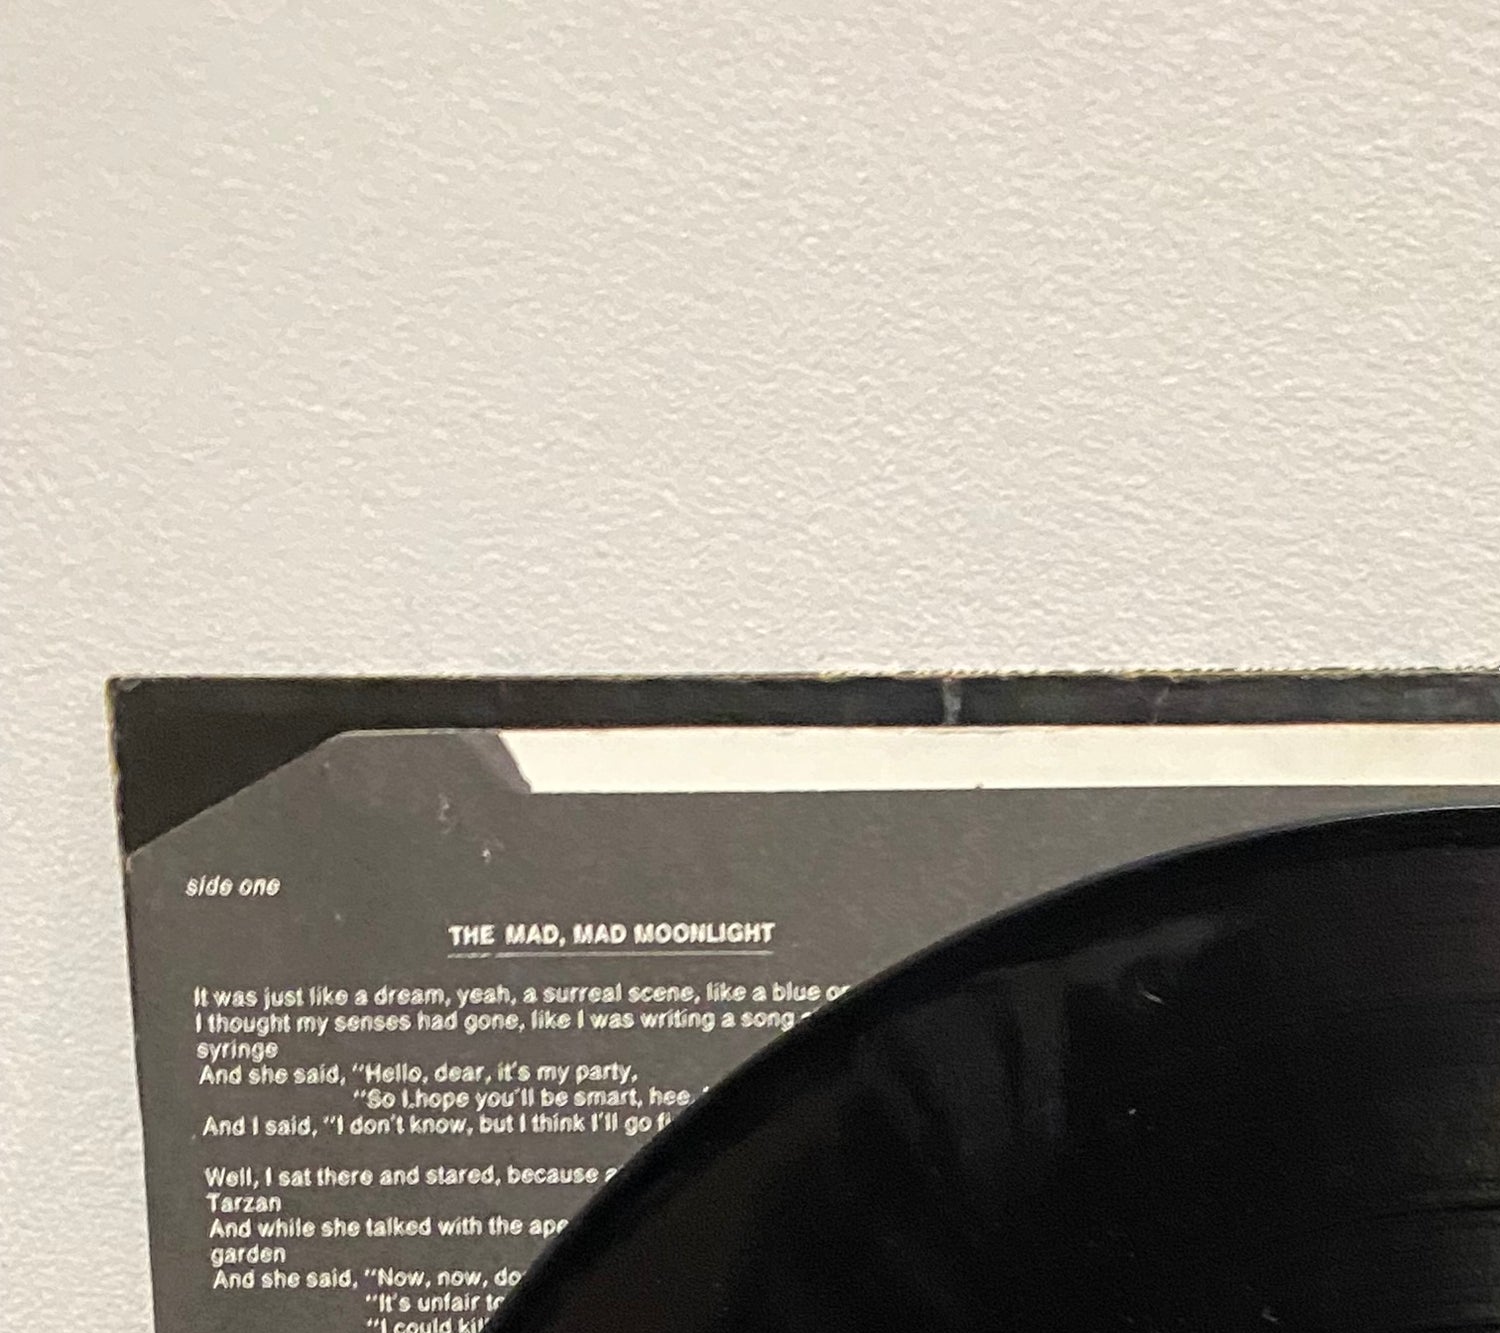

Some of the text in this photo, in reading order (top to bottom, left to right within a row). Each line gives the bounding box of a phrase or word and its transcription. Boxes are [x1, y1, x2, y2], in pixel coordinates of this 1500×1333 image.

[184, 875, 281, 897] side one
[447, 921, 776, 947] THE MAD, MAD MOONLIGHT
[193, 987, 209, 1007] It
[212, 989, 258, 1007] was
[263, 986, 304, 1011] just
[309, 986, 348, 1006] like
[354, 988, 368, 1006] a
[522, 986, 538, 1003] a
[542, 982, 622, 1003] surreal
[705, 981, 747, 1002] like
[751, 985, 767, 1002] a
[771, 980, 821, 1002] blue
[198, 1064, 242, 1085] And
[247, 1064, 288, 1085] she
[536, 1065, 570, 1085] my
[205, 1192, 282, 1213] Tarzan
[210, 1243, 286, 1268] garden
